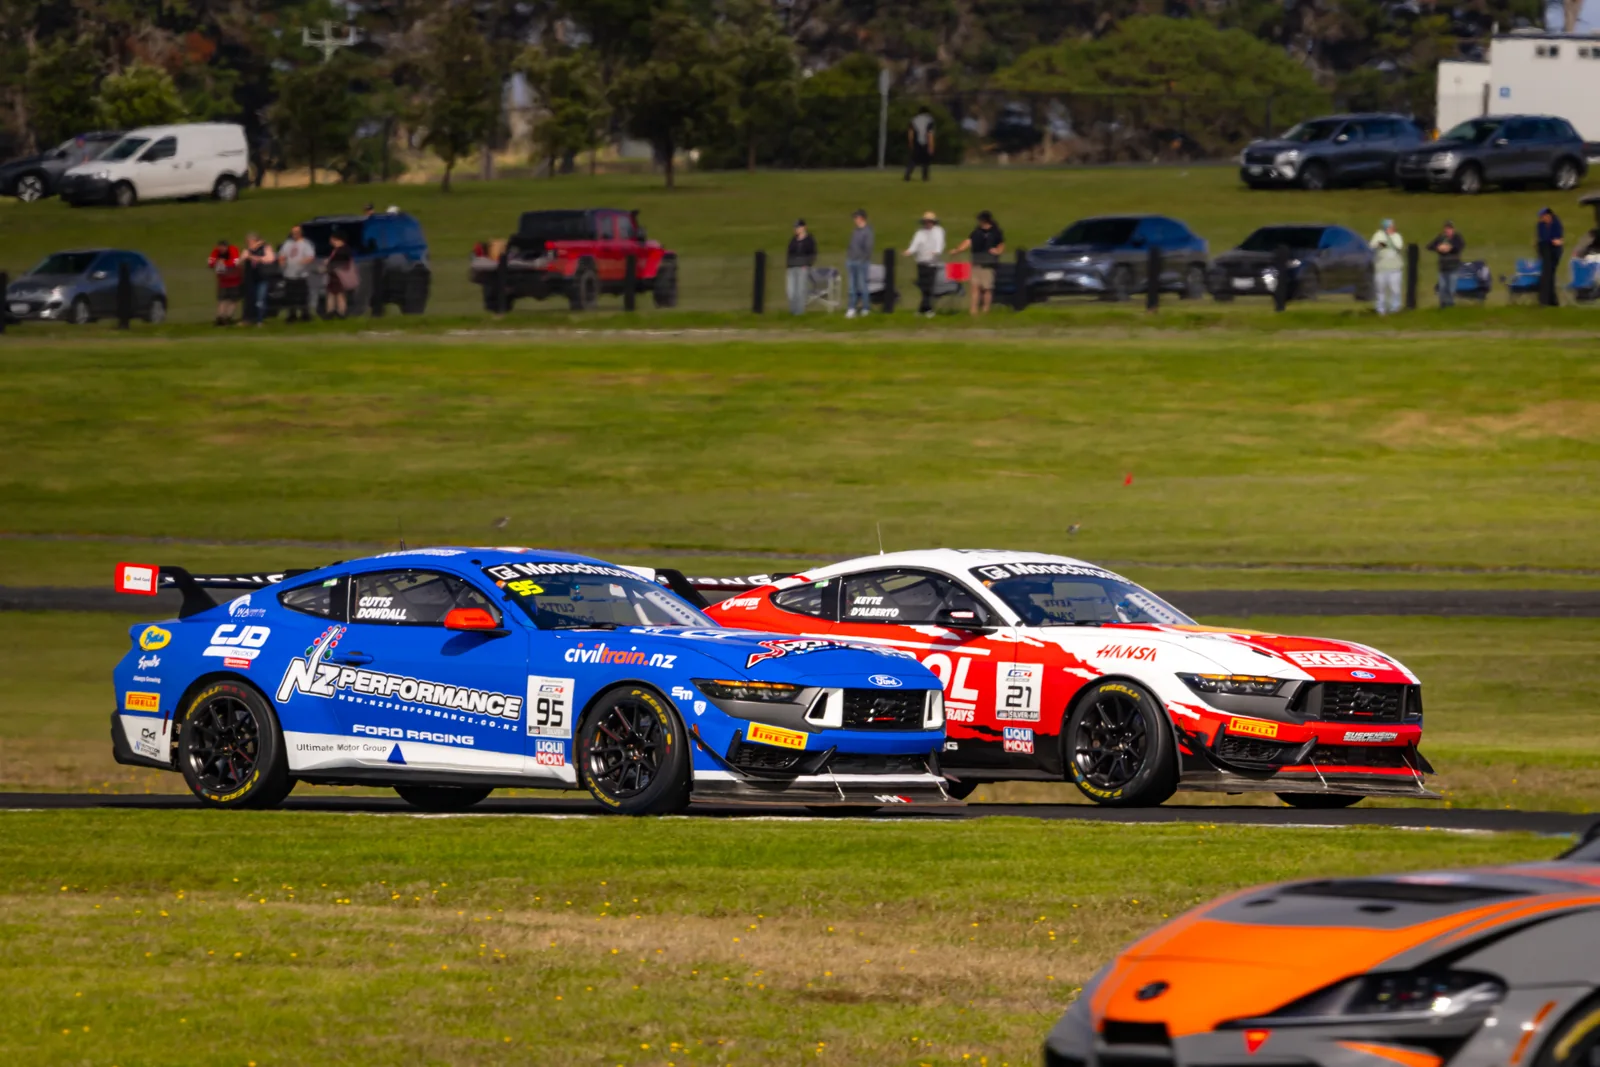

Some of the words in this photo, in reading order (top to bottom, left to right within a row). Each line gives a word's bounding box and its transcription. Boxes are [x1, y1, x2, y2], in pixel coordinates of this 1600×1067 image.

[507, 579, 545, 597] 95
[359, 596, 393, 607] CUTTS
[853, 596, 883, 605] KEYTE
[356, 608, 407, 620] DOWDALL
[850, 607, 899, 617] D'ALBERTO
[564, 643, 677, 669] civiltrain.nz
[338, 669, 523, 719] PERFORMANCE
[1005, 686, 1032, 708] 21
[1099, 684, 1140, 699] PIRELLI
[128, 694, 157, 707] PIRELLI
[537, 698, 564, 727] 95
[353, 724, 404, 738] FORD
[407, 730, 474, 745] RACING
[1005, 728, 1031, 741] LIQUI
[1233, 722, 1277, 736] PIRELLI
[753, 727, 804, 746] PIRELLI
[296, 743, 334, 752] Ultimate
[337, 743, 359, 752] Motor
[363, 744, 387, 753] Group
[537, 742, 563, 753] LIQUI
[1005, 741, 1032, 753] MOLY
[537, 753, 564, 766] MOLY
